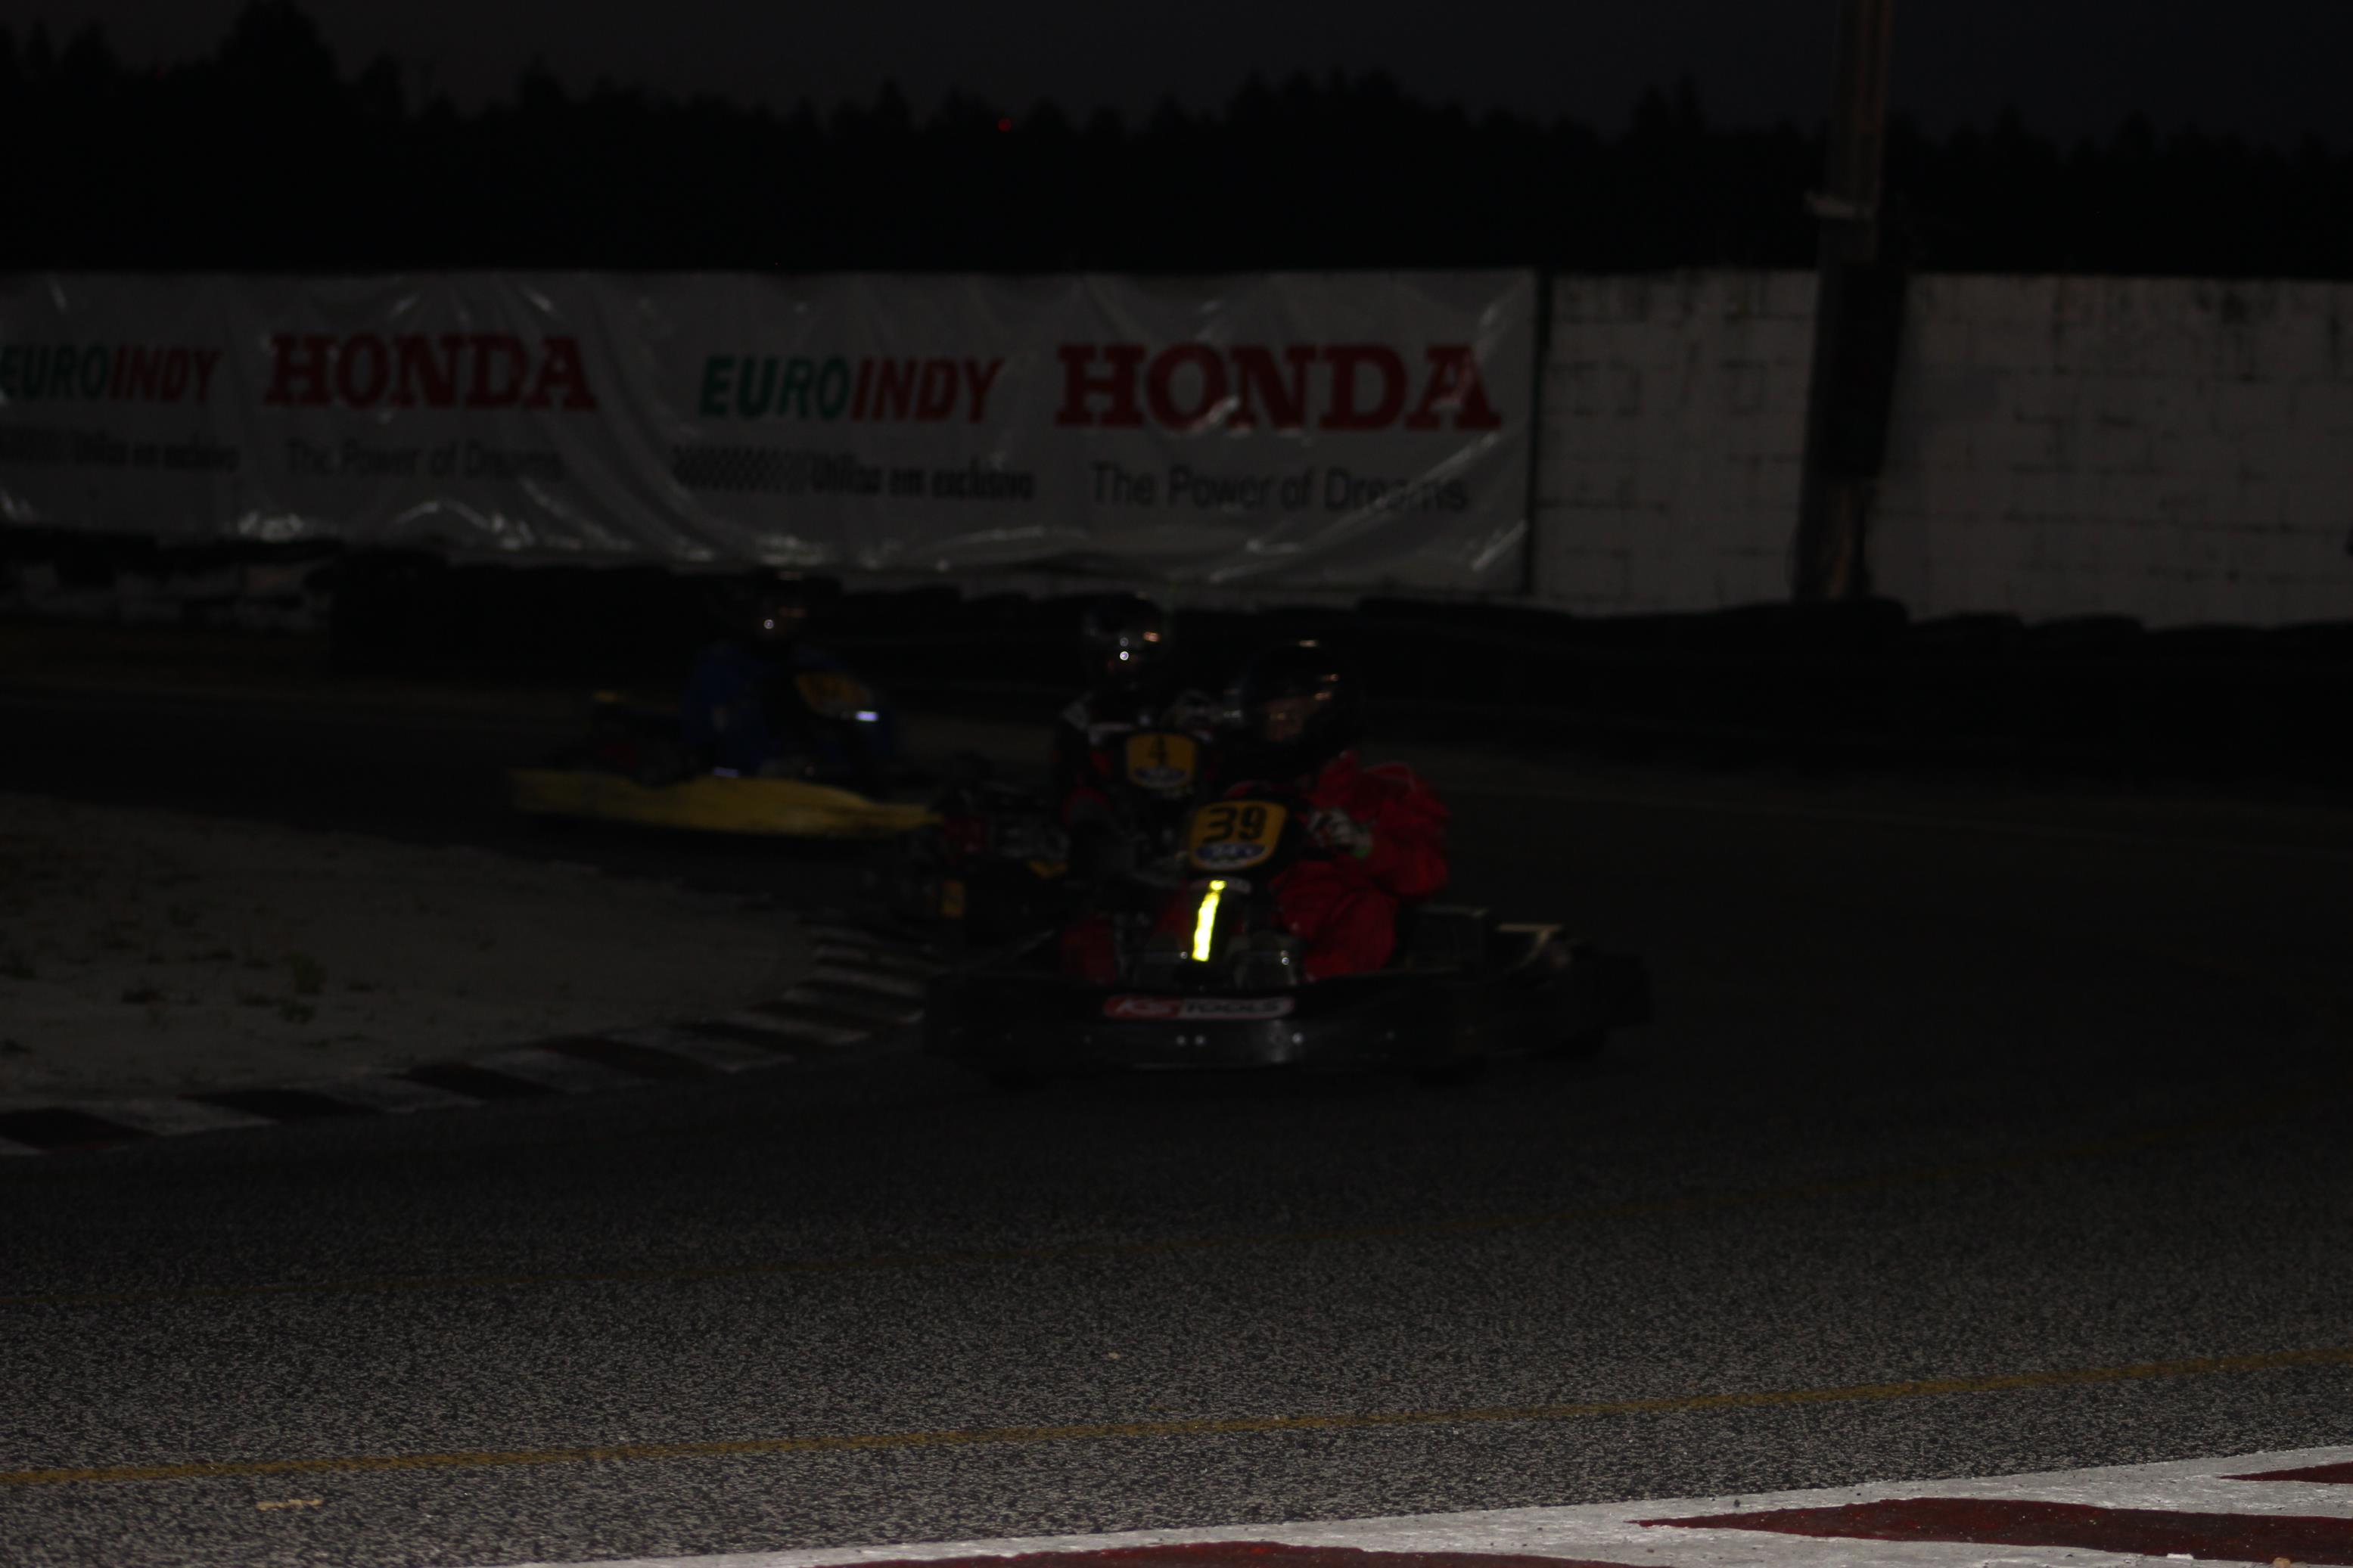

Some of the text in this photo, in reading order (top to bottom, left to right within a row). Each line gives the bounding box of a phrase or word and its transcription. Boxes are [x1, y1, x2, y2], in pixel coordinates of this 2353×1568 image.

[0, 344, 222, 403] EUROINDY
[265, 334, 598, 411] HONDA
[699, 354, 1005, 424] EUROINDY
[1055, 345, 1502, 431] HONDA
[286, 437, 331, 475] The
[343, 437, 422, 477] Power
[429, 440, 458, 477] of
[889, 467, 925, 495] em
[931, 457, 1035, 500] exclusivo
[1091, 462, 1469, 511] The Power of Dreams
[1148, 735, 1167, 765] 4
[1203, 806, 1268, 843] 39
